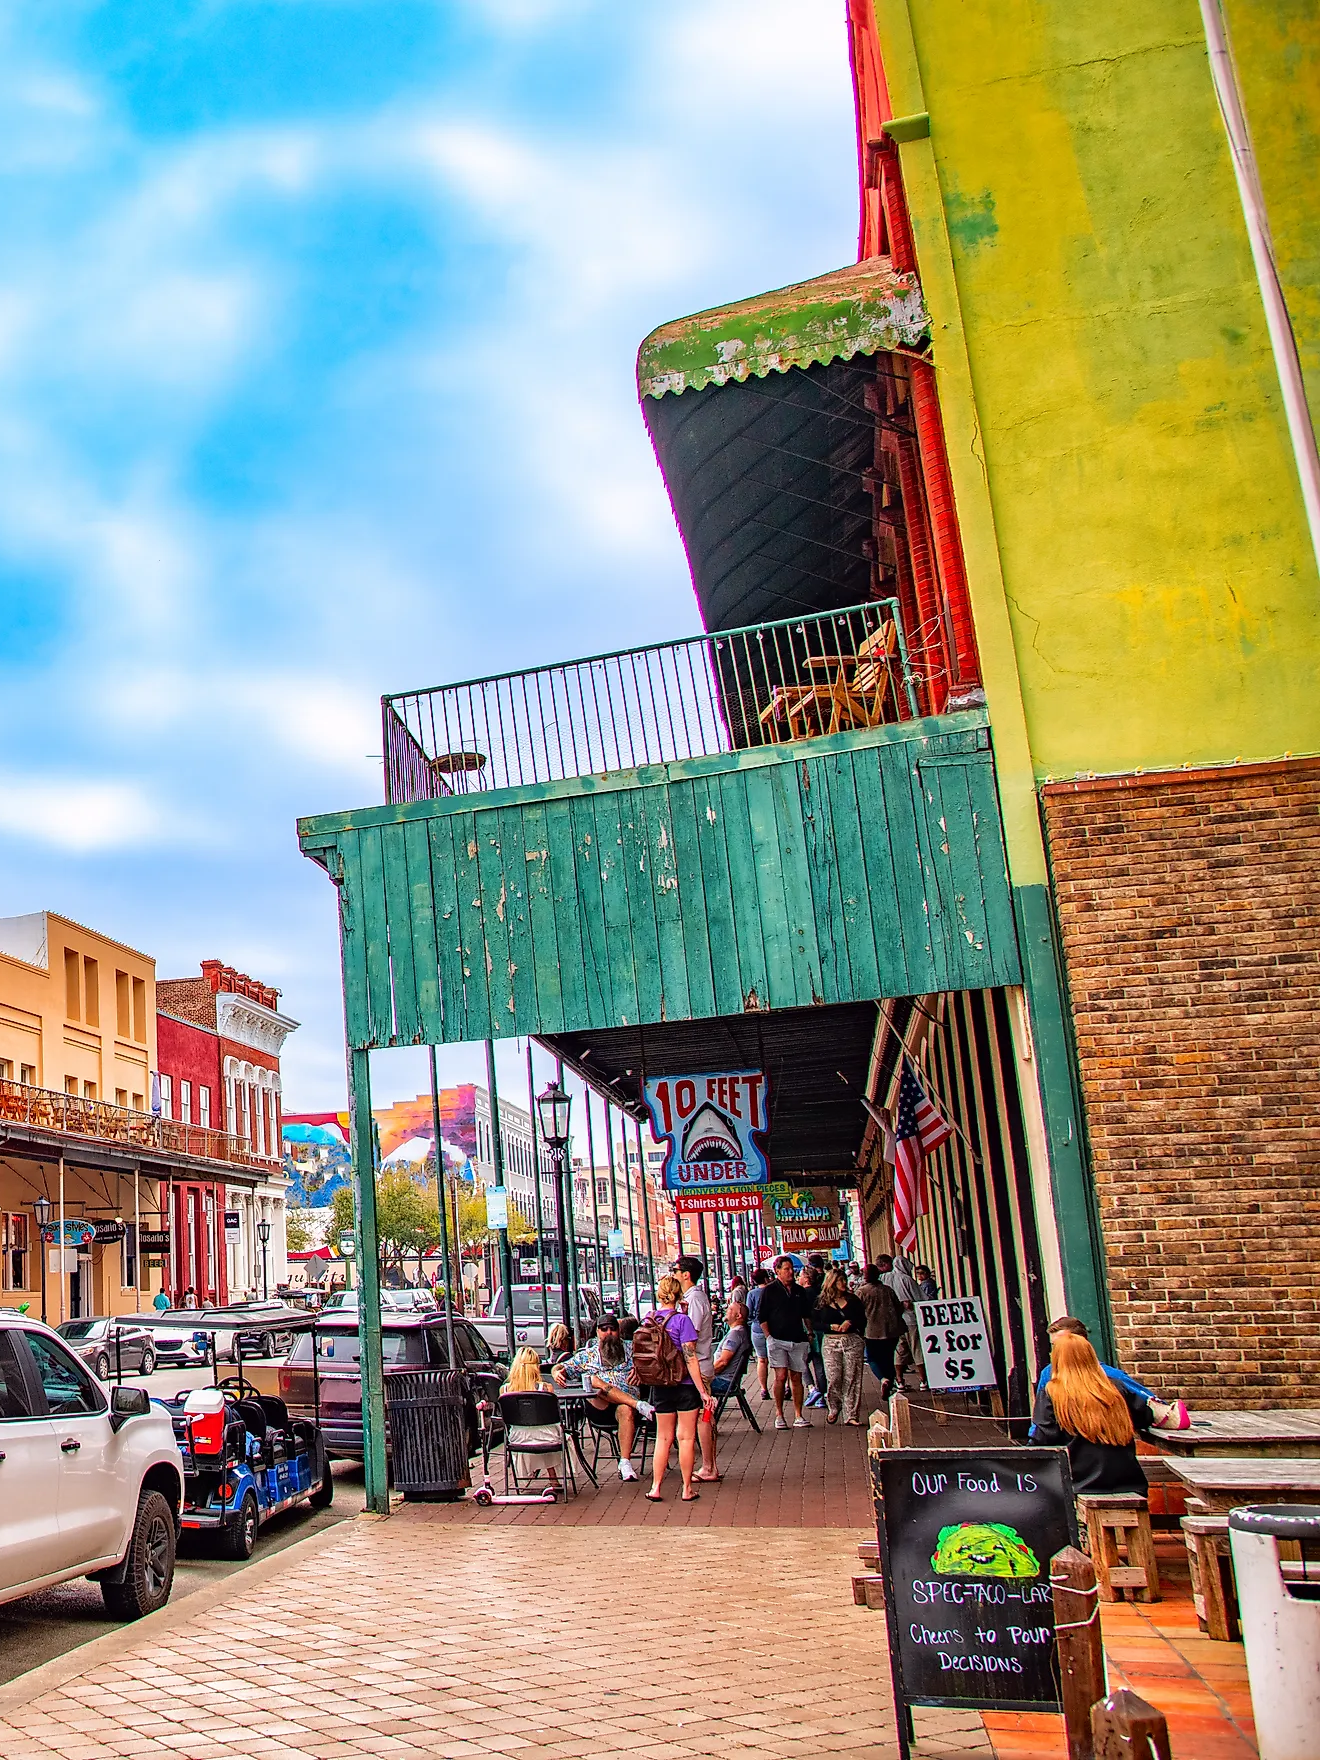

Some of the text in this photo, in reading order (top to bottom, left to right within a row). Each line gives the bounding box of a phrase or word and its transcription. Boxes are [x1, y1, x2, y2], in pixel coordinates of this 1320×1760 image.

[655, 1073, 763, 1134] 10 FEET
[677, 1161, 749, 1182] UNDER
[756, 1183, 786, 1193] PIECES
[679, 1195, 759, 1209] T-Shirts 3 for $10
[94, 1222, 124, 1233] osario's
[783, 1226, 840, 1243] PELICAN ISLAND
[920, 1301, 979, 1327] BEER
[925, 1329, 983, 1354] 2 for
[944, 1357, 976, 1381] $5
[957, 1472, 1001, 1493] Food
[909, 1623, 1051, 1646] Cheers to Pour
